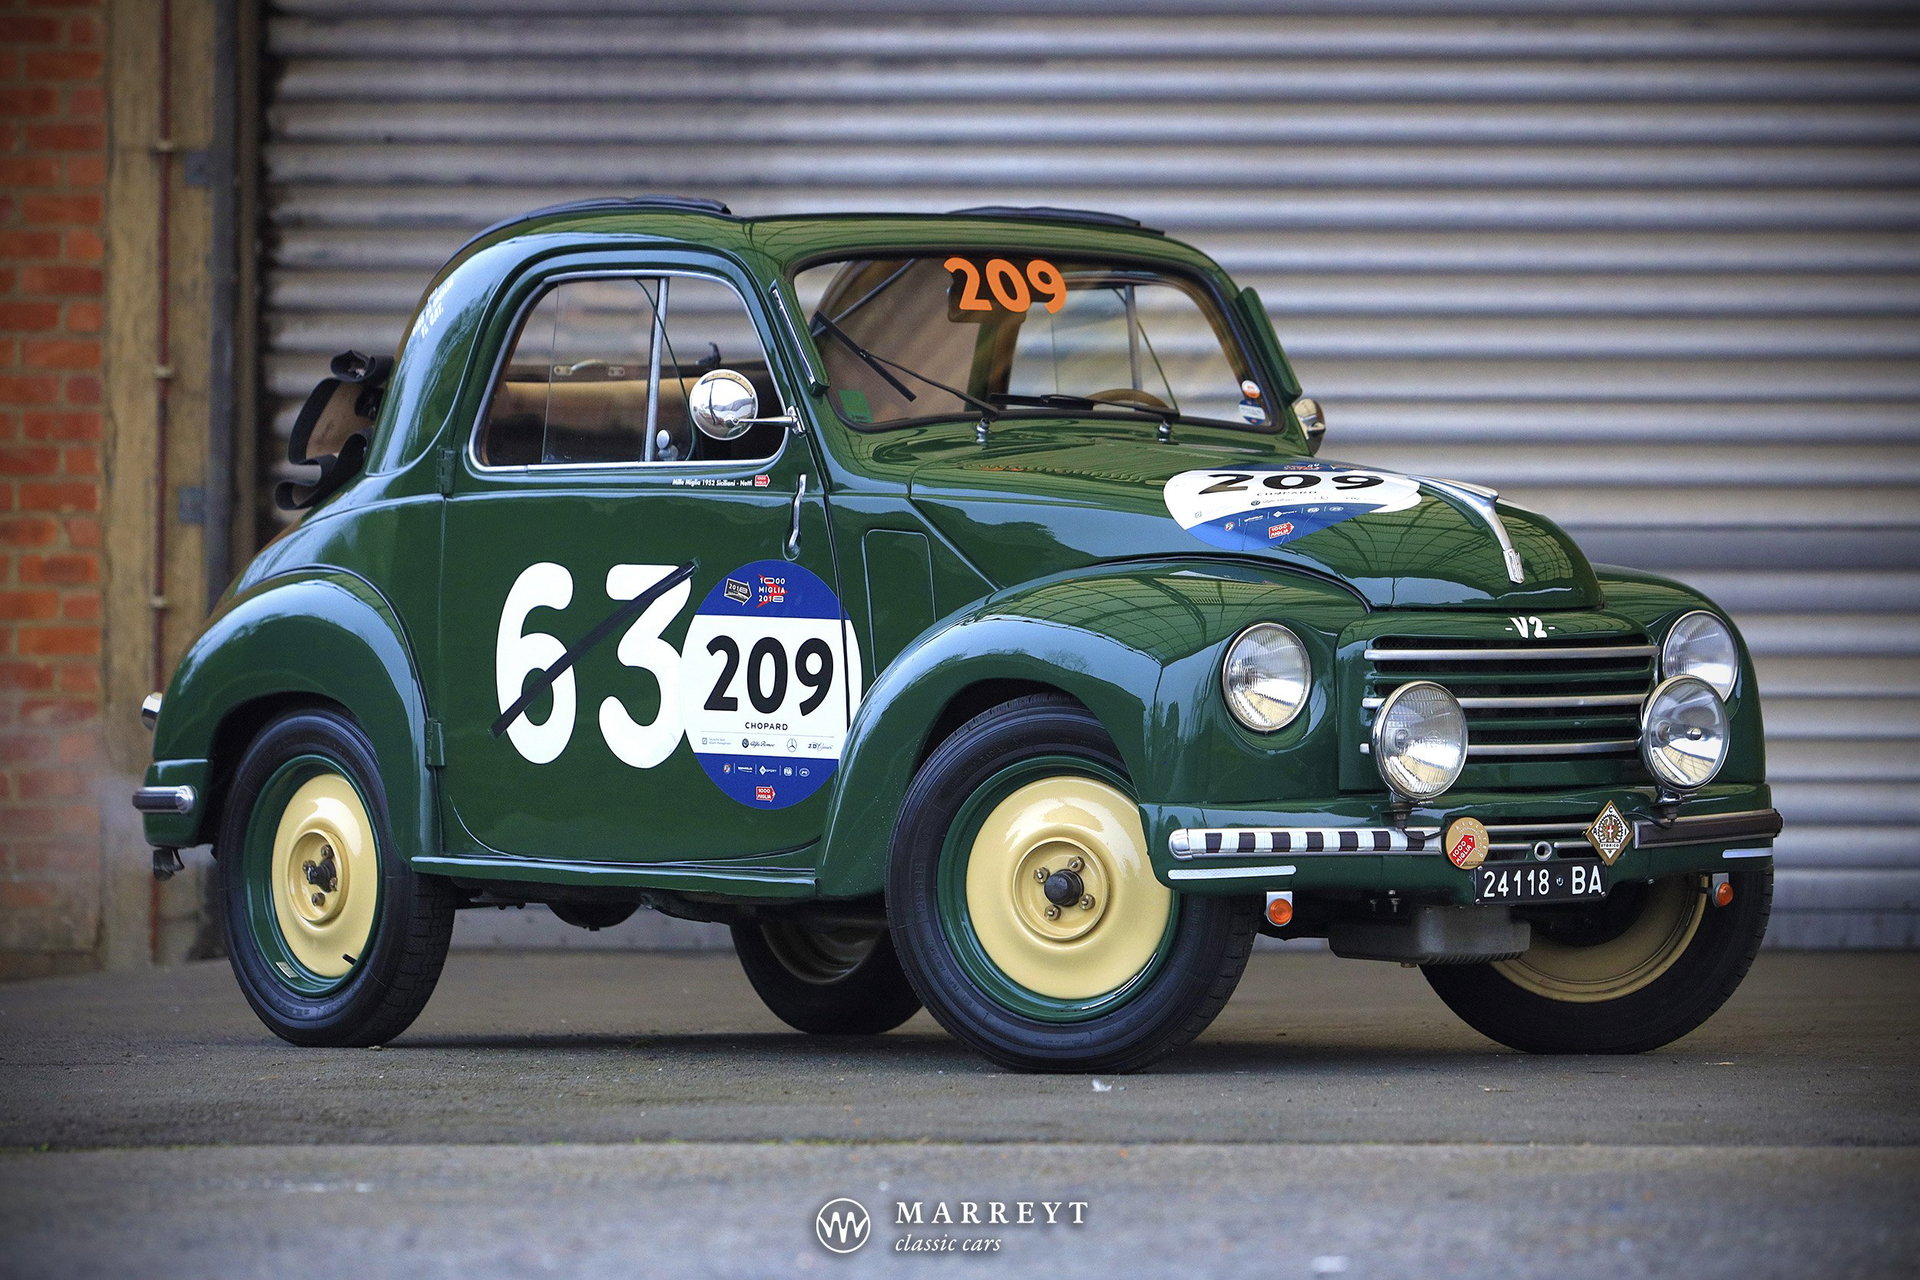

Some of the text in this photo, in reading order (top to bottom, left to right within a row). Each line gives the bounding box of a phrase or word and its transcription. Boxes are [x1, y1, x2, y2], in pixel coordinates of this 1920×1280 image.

[943, 257, 1068, 314] 209
[685, 479, 701, 487] Miglia
[1198, 474, 1385, 495] 209
[758, 586, 786, 594] MIGLIA
[495, 561, 691, 769] 63
[703, 634, 834, 717] 209
[744, 721, 789, 731] CHOPARD
[1452, 840, 1467, 858] 1000
[1456, 844, 1473, 865] MIGLIA
[1483, 865, 1602, 898] 24118 BA
